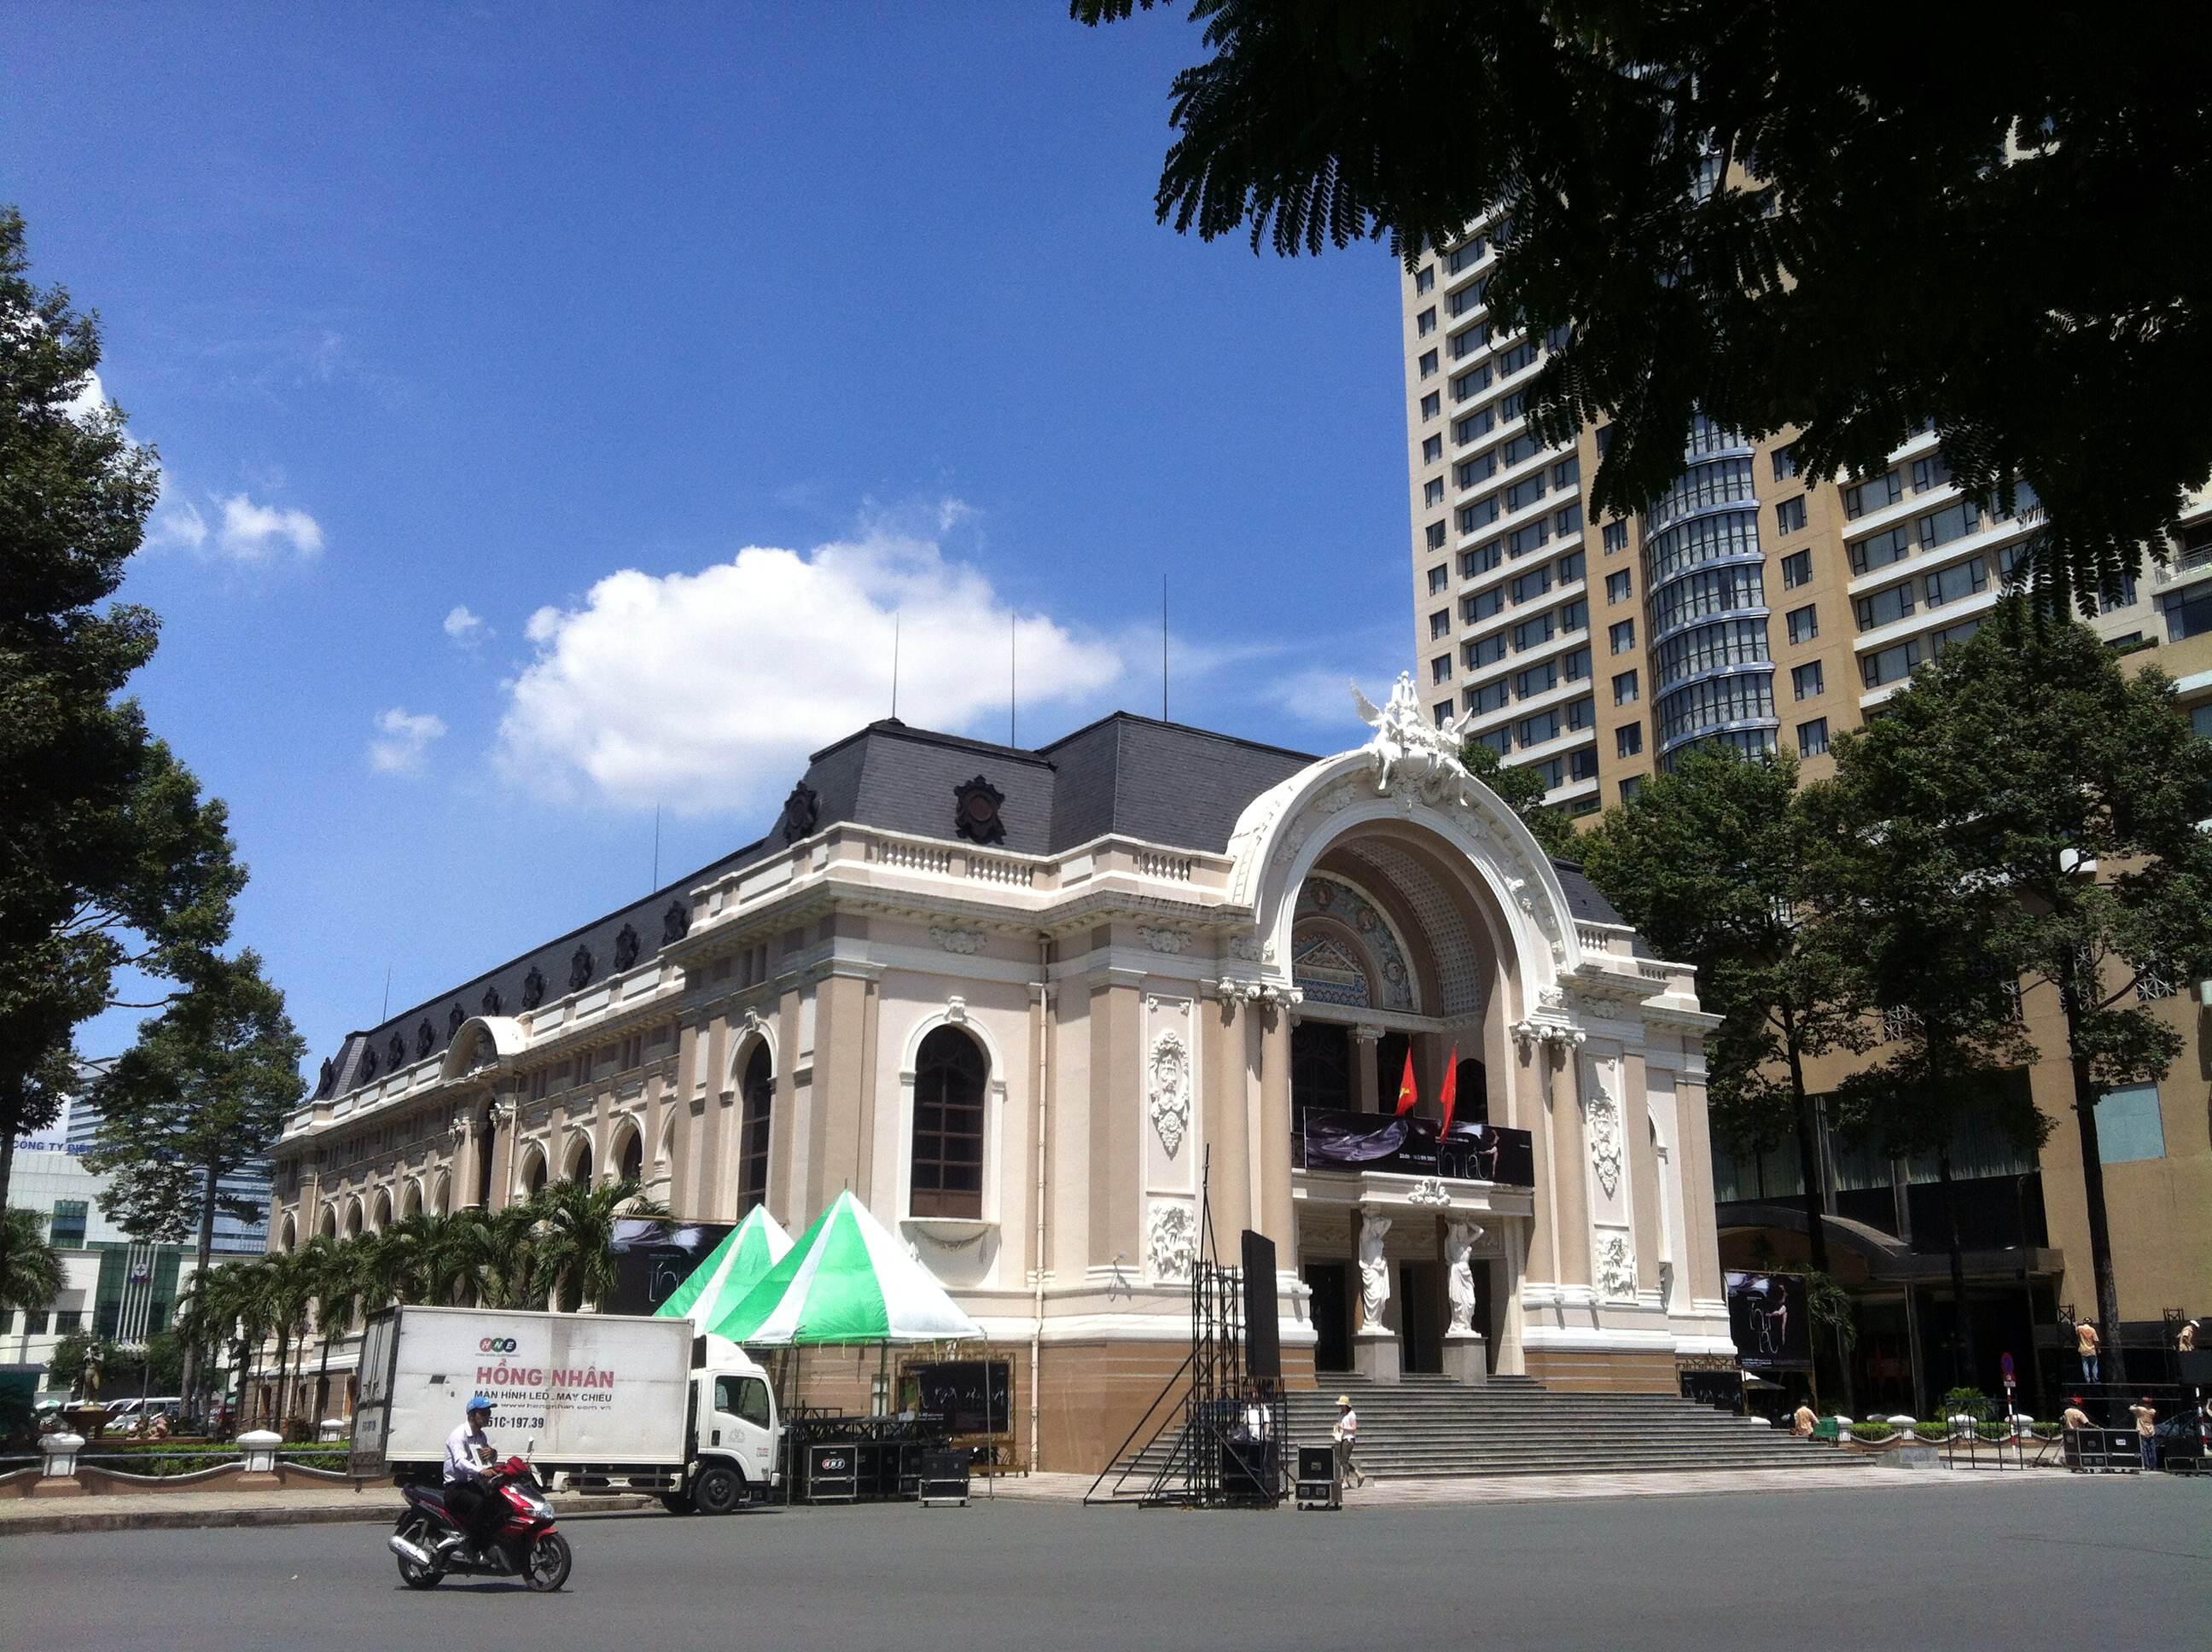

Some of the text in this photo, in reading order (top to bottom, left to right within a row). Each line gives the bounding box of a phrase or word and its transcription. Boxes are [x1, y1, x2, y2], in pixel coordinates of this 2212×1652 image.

[49, 1143, 63, 1151] TY
[480, 1339, 516, 1352] HNE
[551, 1366, 614, 1387] NHÂN
[529, 1392, 550, 1400] LED
[486, 1416, 544, 1428] 51C-197.39
